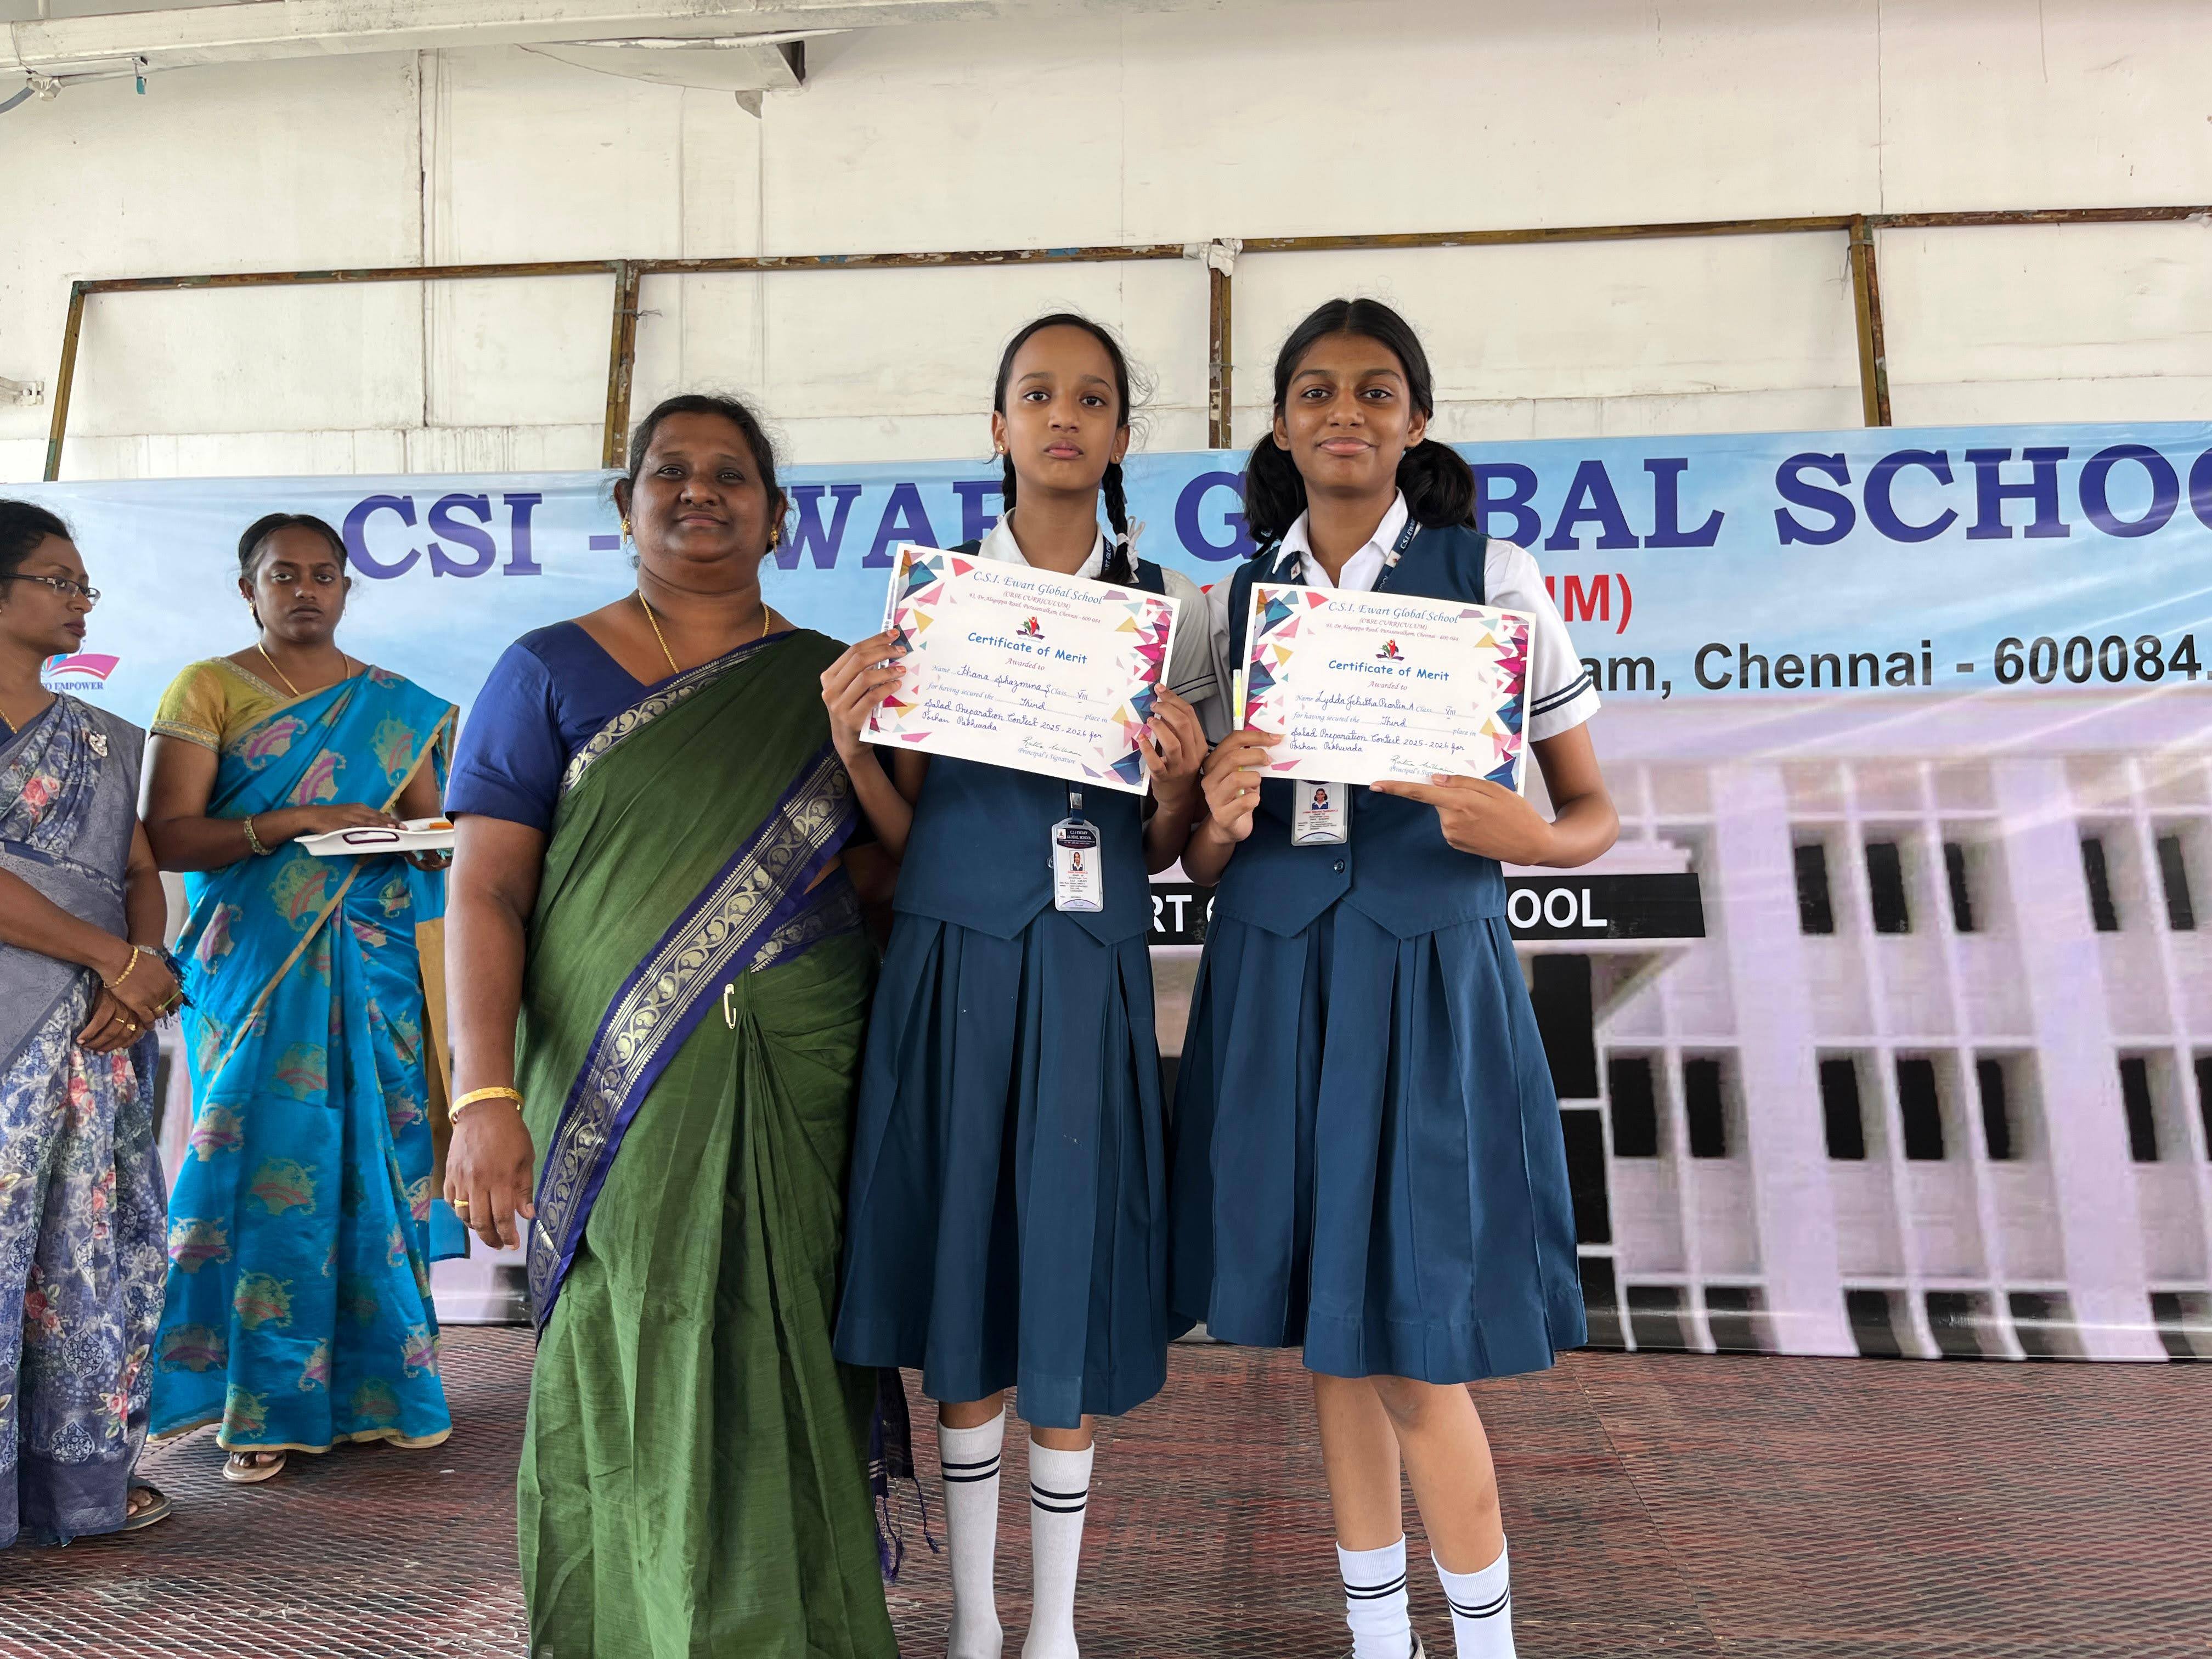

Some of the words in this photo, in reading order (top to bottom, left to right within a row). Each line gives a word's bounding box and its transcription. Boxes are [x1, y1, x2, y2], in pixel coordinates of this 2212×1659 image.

[342, 493, 543, 579] CSI
[589, 535, 620, 550] -
[1175, 458, 1725, 562] GBAL
[1774, 443, 2212, 545] SCHO
[973, 571, 1000, 584] C.S.I.
[1003, 577, 1035, 590] Ewart
[1038, 584, 1071, 598] Global
[1070, 591, 1105, 605] School
[1023, 594, 1071, 609] CURRICULUM)
[1329, 601, 1355, 613] C.S.I.
[1358, 604, 1390, 616] Ewart
[1393, 608, 1427, 619] Global
[1426, 612, 1462, 624] School
[1379, 619, 1427, 631] CURRICULUM)
[968, 632, 1032, 653] Certificate
[1037, 646, 1051, 657] of
[1054, 649, 1088, 664] Merit
[1005, 657, 1037, 670] Awarded
[1328, 660, 1393, 675] Certificate
[1398, 667, 1412, 678] of
[1417, 668, 1450, 681] Merit
[1694, 639, 1932, 691] Chennai
[1956, 662, 1975, 673] -
[54, 681, 104, 690] EMPOWER
[932, 665, 951, 674] Name
[1051, 687, 1067, 697] Class
[1367, 680, 1400, 690] Awarded
[927, 682, 937, 690] for
[939, 684, 960, 696] having
[961, 689, 983, 698] secured
[984, 692, 995, 701] the
[1019, 697, 1046, 710] Third
[1084, 714, 1101, 722] place
[924, 698, 953, 712] Salad
[955, 703, 1005, 721] Preparation
[1007, 713, 1039, 727] Contest
[1088, 730, 1103, 743] for
[1292, 712, 1304, 720] for
[1304, 712, 1325, 722] having
[1326, 715, 1349, 723] secured
[1379, 716, 1407, 727] Third
[1290, 727, 1318, 742] Salad
[1319, 728, 1368, 744] Preparation
[1371, 733, 1401, 744] Contest
[1450, 742, 1465, 755] for
[1017, 747, 1048, 759] Principal's
[1049, 753, 1076, 764] Signature
[1389, 766, 1420, 775] Principal's
